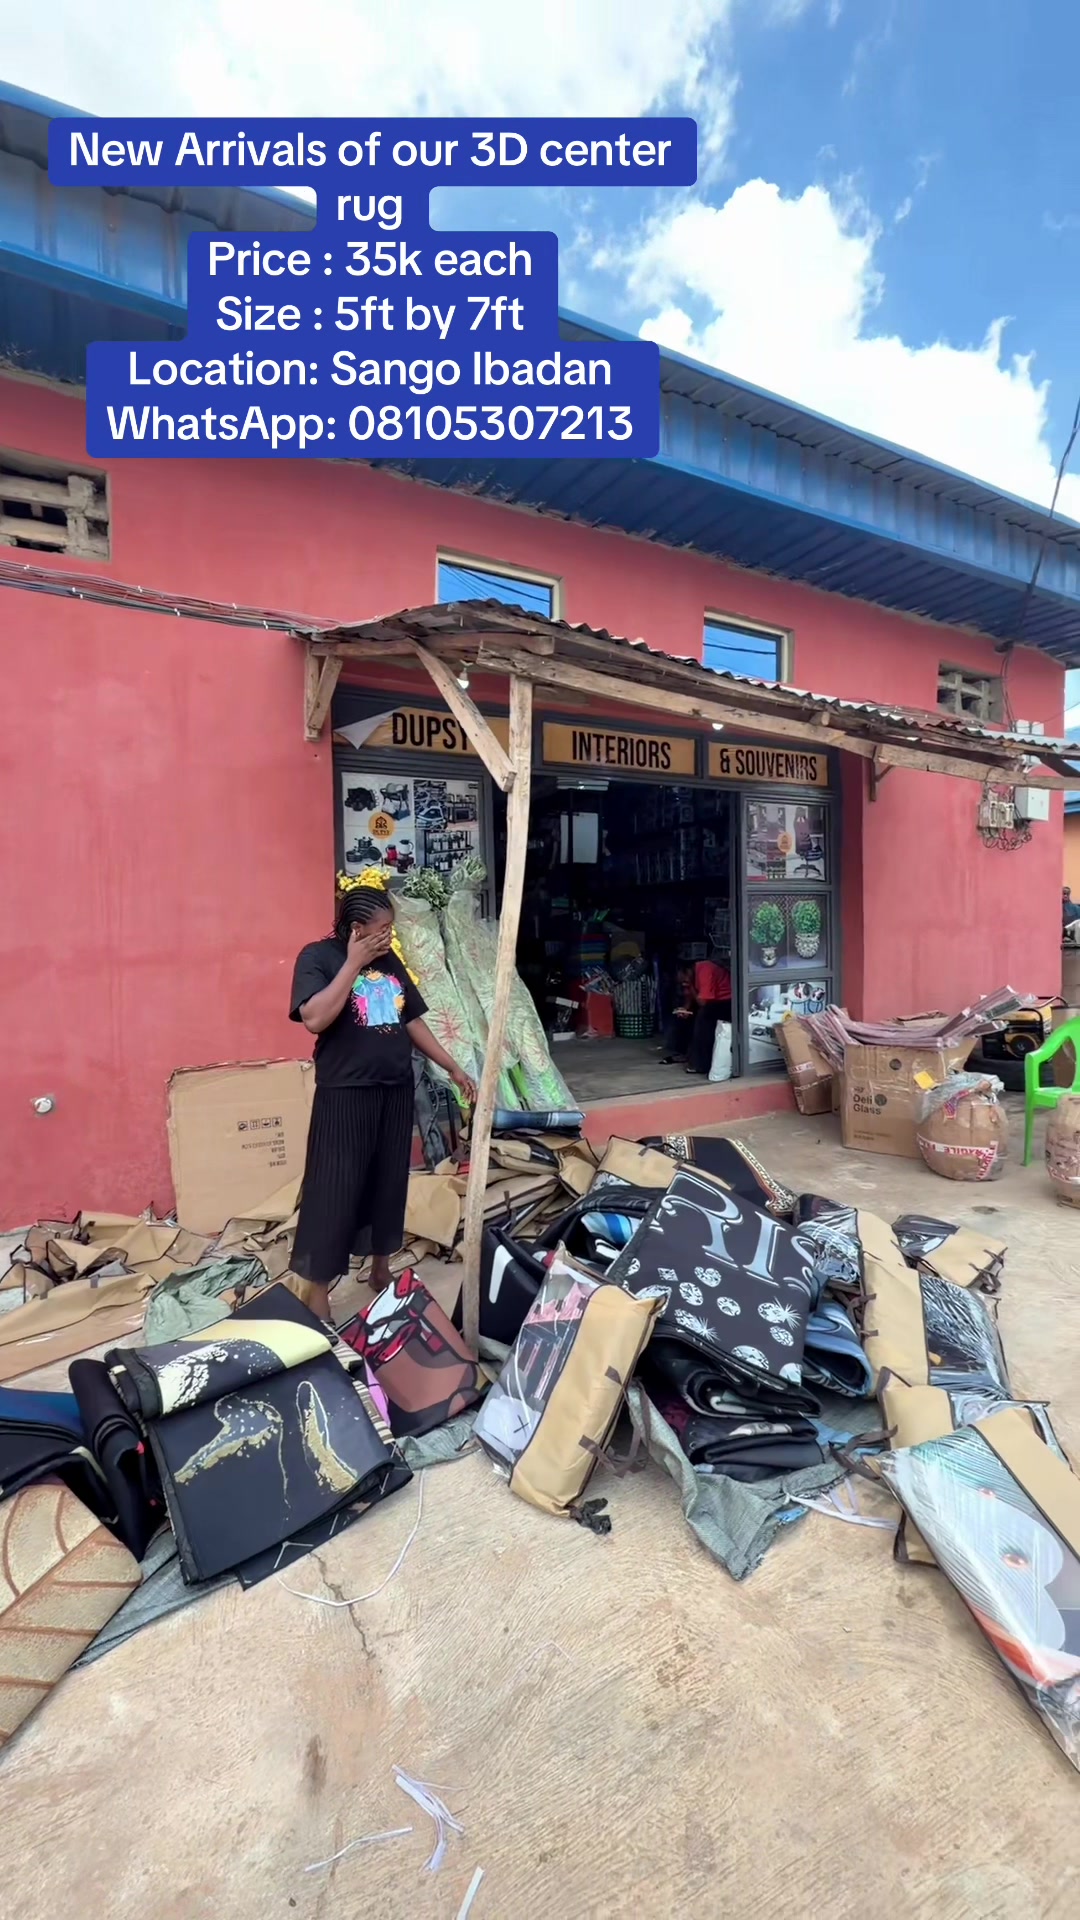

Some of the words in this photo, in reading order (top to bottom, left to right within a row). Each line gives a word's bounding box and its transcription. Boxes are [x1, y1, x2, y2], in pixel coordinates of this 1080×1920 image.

[392, 712, 468, 751] DUPSY
[572, 730, 671, 770] INTERIORS
[719, 748, 730, 774] &
[735, 749, 817, 781] SOUVENIRS
[853, 1093, 873, 1105] Deli
[853, 1103, 882, 1116] Glass
